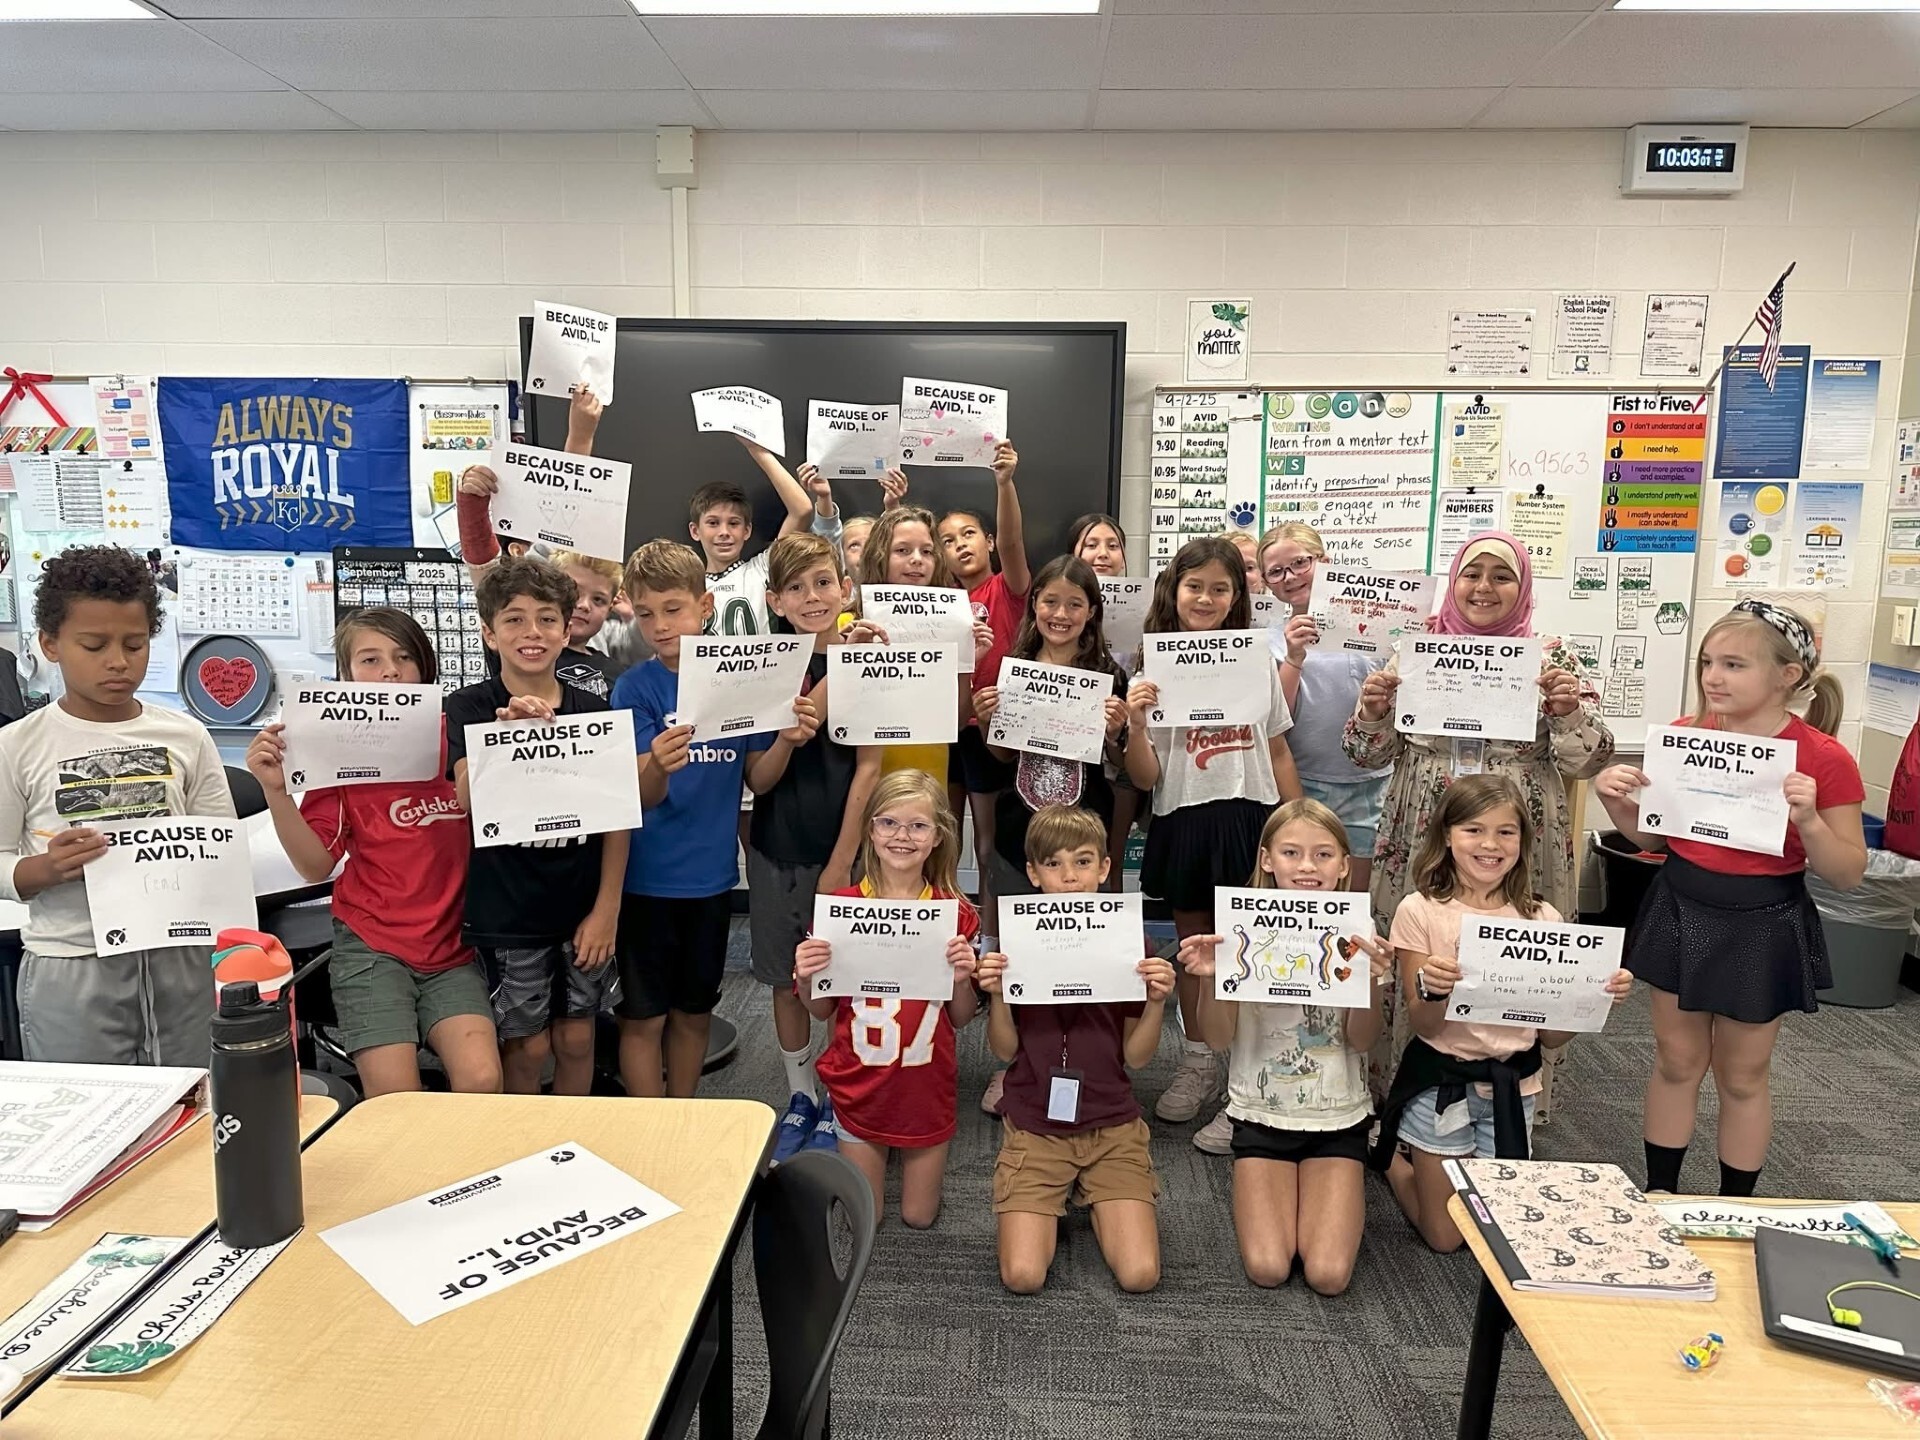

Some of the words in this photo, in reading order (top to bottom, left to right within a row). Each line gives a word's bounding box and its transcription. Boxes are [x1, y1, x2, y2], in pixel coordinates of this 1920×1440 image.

[1657, 148, 1700, 166] 10:03
[546, 311, 596, 329] BECAUSE
[598, 321, 609, 332] OF
[561, 328, 590, 343] AVID,
[1203, 327, 1236, 342] you
[1198, 340, 1241, 356] MATTER
[914, 387, 975, 402] BECAUSE
[978, 393, 996, 404] OF
[930, 400, 966, 414] AVID,
[1276, 394, 1286, 415] I
[1464, 406, 1490, 415] AVID
[1612, 396, 1641, 412] Fist
[1644, 400, 1656, 410] to
[1660, 396, 1691, 412] Five
[212, 395, 354, 448] ALWAYS
[1158, 416, 1175, 427] 9:10
[1194, 414, 1218, 422] AVID
[1272, 422, 1331, 434] WRITING
[1156, 440, 1176, 452] 9:30
[1186, 438, 1224, 448] Reading
[1270, 436, 1298, 449] learn
[1302, 435, 1332, 448] from
[1337, 438, 1345, 447] a
[1350, 432, 1393, 447] mentor
[1400, 430, 1429, 446] text
[1665, 446, 1680, 454] help.
[211, 442, 355, 508] ROYAL
[505, 452, 585, 477] BECAUSE
[589, 467, 614, 482] OF
[1154, 466, 1176, 478] 10:35
[1670, 466, 1695, 474] practice
[524, 470, 568, 492] AVID,
[573, 478, 592, 494] I...
[1270, 477, 1318, 493] identify
[1324, 474, 1390, 490] prepositional
[1396, 474, 1432, 490] phrases
[1654, 474, 1686, 482] examples.
[1154, 488, 1177, 500] 10:50
[1195, 489, 1212, 498] Art
[1664, 492, 1684, 500] pretty
[1265, 502, 1319, 512] READING
[1324, 500, 1373, 518] engage
[1382, 500, 1394, 509] in
[1401, 498, 1422, 509] the
[1446, 503, 1494, 513] NUMBERS
[1156, 515, 1175, 526] 11:40
[1311, 514, 1328, 526] of
[1334, 516, 1342, 526] a
[1350, 512, 1378, 526] text
[1631, 512, 1651, 520] mostly
[1326, 536, 1364, 550] make
[1374, 537, 1413, 550] Sense
[343, 566, 399, 579] September
[418, 568, 446, 579] 2025
[1326, 572, 1396, 590] BECAUSE
[1400, 580, 1421, 592] OF
[1342, 586, 1380, 602] AVID,
[1384, 592, 1401, 604] I...
[446, 614, 453, 625] 4
[469, 616, 476, 626] 5
[1656, 614, 1687, 624] Lunch?
[444, 638, 456, 648] 11
[466, 638, 480, 648] 12
[696, 643, 772, 658] BECAUSE
[776, 642, 800, 652] OF
[1156, 639, 1229, 652] BECAUSE
[1232, 637, 1254, 650] OF
[1414, 642, 1494, 656] BECAUSE
[1500, 646, 1525, 658] OF
[716, 660, 758, 674] AVID,
[762, 657, 778, 670] I...
[841, 651, 916, 664] BECAUSE
[921, 651, 943, 663] OF
[1175, 652, 1216, 666] AVID,
[1220, 651, 1237, 664] I...
[1434, 658, 1480, 672] AVID,
[1484, 660, 1504, 672] I...
[861, 666, 904, 680] AVID,
[908, 666, 926, 678] I...
[299, 690, 389, 706] BECAUSE
[395, 694, 422, 706] OF
[320, 708, 374, 723] AVID,
[379, 709, 400, 722] I...
[484, 726, 581, 747] BECAUSE
[586, 722, 614, 736] OF
[511, 744, 566, 762] AVID,
[572, 742, 594, 758] I...
[688, 744, 737, 762] mbro
[1662, 734, 1746, 757] BECAUSE
[1751, 746, 1776, 762] OF
[1684, 754, 1731, 774] AVID,
[1735, 760, 1755, 776] I...
[389, 796, 460, 828] Carlsbe
[106, 827, 206, 848] BECAUSE
[212, 828, 233, 842] OF
[134, 844, 194, 863] AVID,
[830, 905, 912, 921] BECAUSE
[918, 908, 941, 922] OF
[1014, 902, 1094, 916] BECAUSE
[1100, 901, 1124, 914] OF
[1230, 896, 1318, 914] BECAUSE
[1324, 901, 1351, 916] OF
[850, 922, 898, 937] AVID,
[901, 924, 920, 936] I...
[1036, 917, 1082, 932] AVID,
[1086, 916, 1106, 930] I...
[1253, 914, 1304, 932] AVID,
[1308, 917, 1330, 931] I...
[1478, 926, 1570, 947] BECAUSE
[1576, 934, 1604, 949] OF
[1500, 946, 1552, 964] AVID,
[1558, 950, 1579, 964] I...
[1540, 974, 1576, 984] about
[1528, 986, 1562, 998] taking
[850, 997, 944, 1068] 87
[503, 1210, 590, 1246] AVID,
[1758, 1216, 1854, 1232] Coulte
[492, 1206, 648, 1276] BECAUSE
[458, 1247, 502, 1264] I...
[137, 1290, 202, 1340] Chris
[192, 1246, 250, 1286] Porte
[439, 1273, 488, 1300] OF
